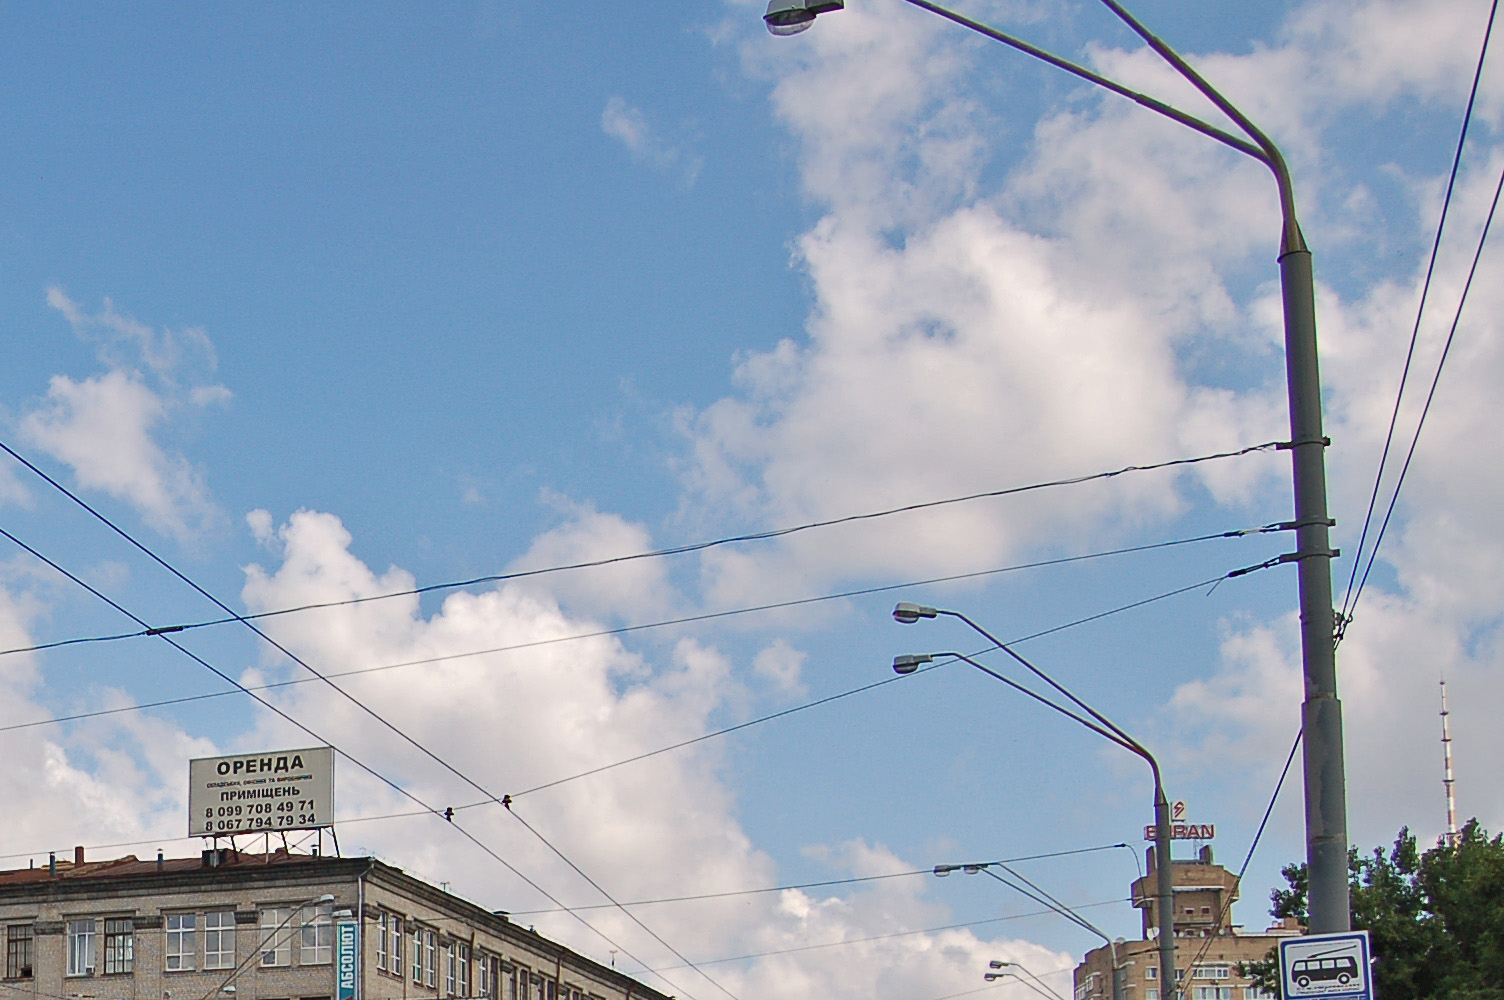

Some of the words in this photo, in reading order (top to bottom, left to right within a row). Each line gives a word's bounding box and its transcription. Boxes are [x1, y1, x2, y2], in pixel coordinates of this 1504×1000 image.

[217, 755, 303, 775] ОРЕНДА
[220, 786, 300, 801] ПРИМІЩЕНЬ
[206, 808, 213, 818] 8
[218, 806, 242, 816] 099
[246, 803, 272, 814] 708
[277, 801, 294, 812] 49
[298, 799, 314, 810] 71
[206, 821, 213, 831] 8
[218, 819, 242, 830] 067
[246, 817, 272, 827] 794
[277, 815, 294, 826] 79
[298, 813, 315, 824] 34
[1146, 825, 1214, 838] BRAN
[341, 926, 354, 989] АБСОЛЮТ
